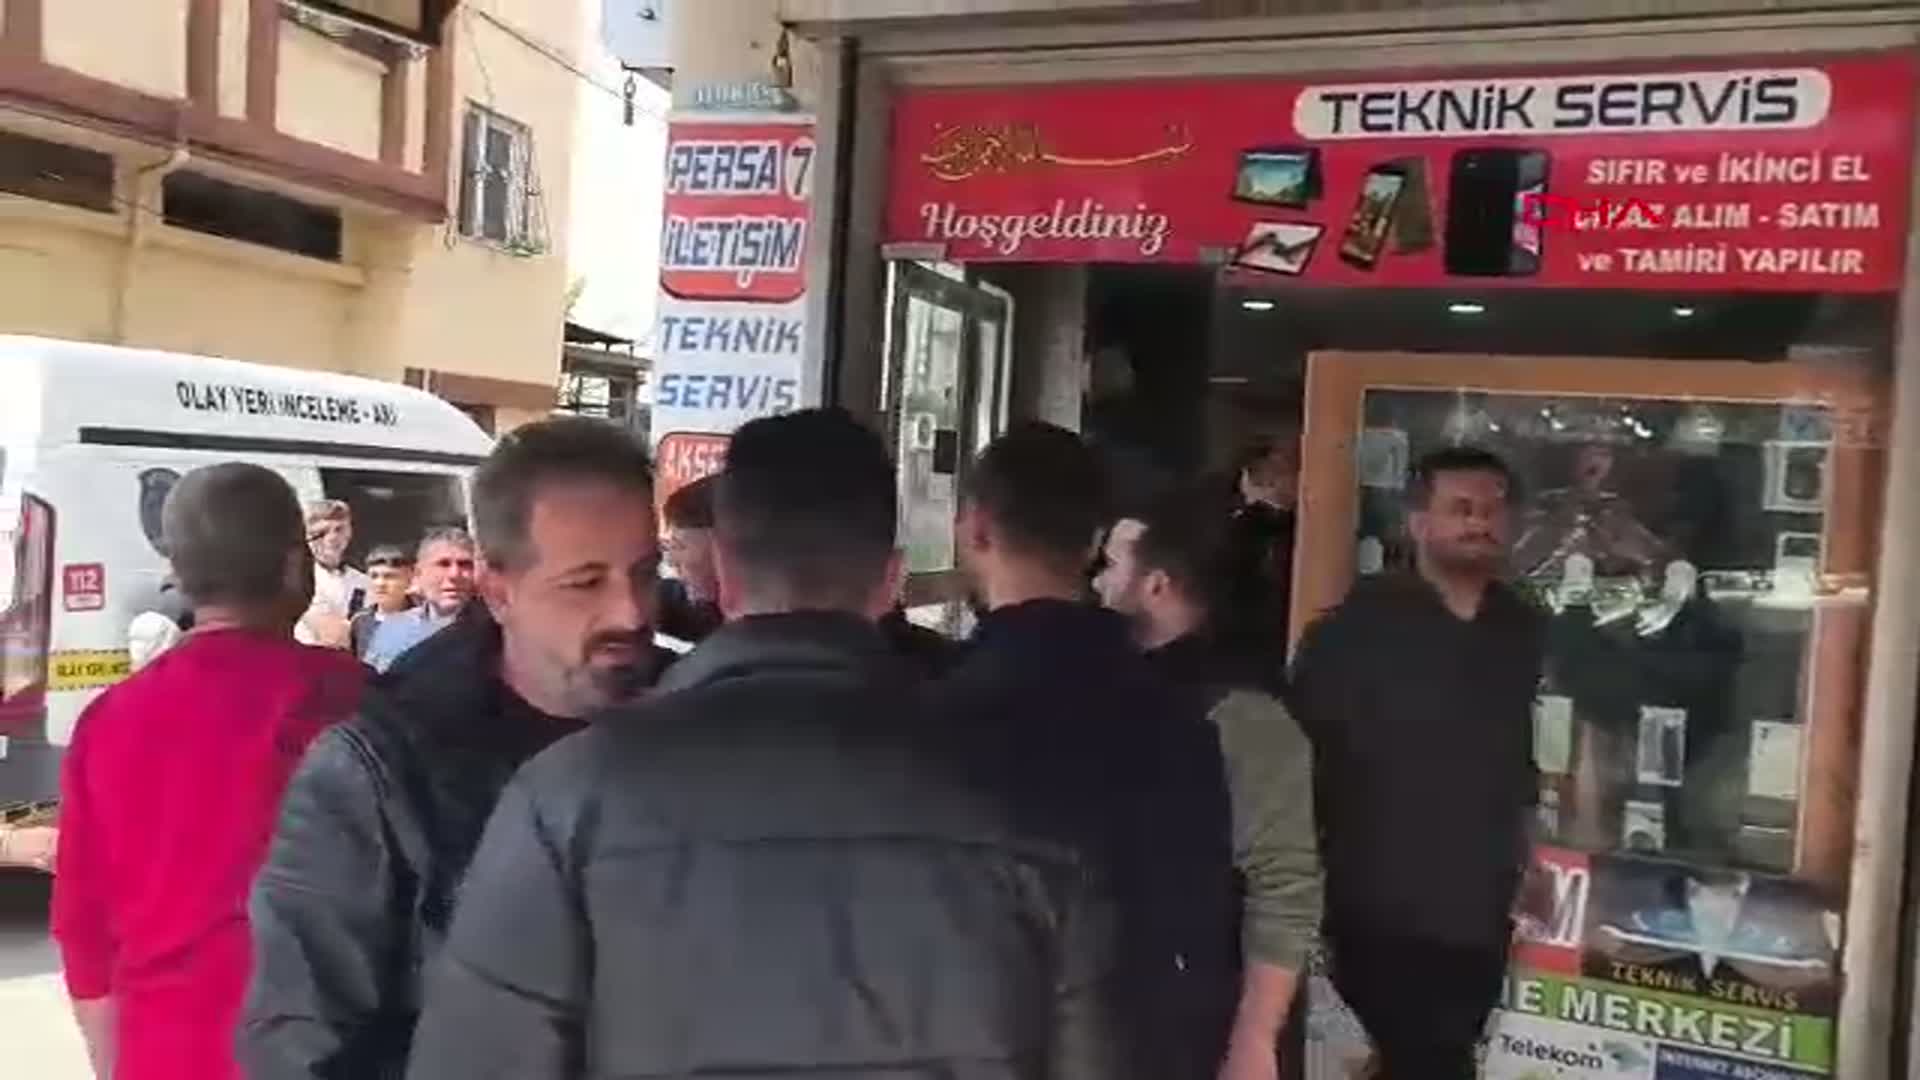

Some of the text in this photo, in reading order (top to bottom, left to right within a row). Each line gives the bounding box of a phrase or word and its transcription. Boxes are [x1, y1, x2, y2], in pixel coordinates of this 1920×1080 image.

[1320, 74, 1799, 135] TEKNİK SERVİS
[669, 144, 814, 196] PERSA 7
[1586, 152, 1871, 184] SIFIR ve İKİNCİ EL
[920, 199, 1172, 254] Hoşgeldiniz
[1671, 203, 1750, 229] ALIM
[1778, 203, 1880, 229] SATIM
[665, 218, 802, 281] İLETİŞİM
[1578, 243, 1865, 274] ve TAMİRİ YAPILIR
[661, 316, 802, 353] TEKNİK
[176, 380, 227, 412] OLAY
[657, 374, 798, 413] SERVİS
[67, 570, 99, 592] 112
[1611, 960, 1800, 1009] TEKNİK SERVİS
[1561, 985, 1794, 1060] MERKEZİ
[1500, 1033, 1604, 1071] Telekom
